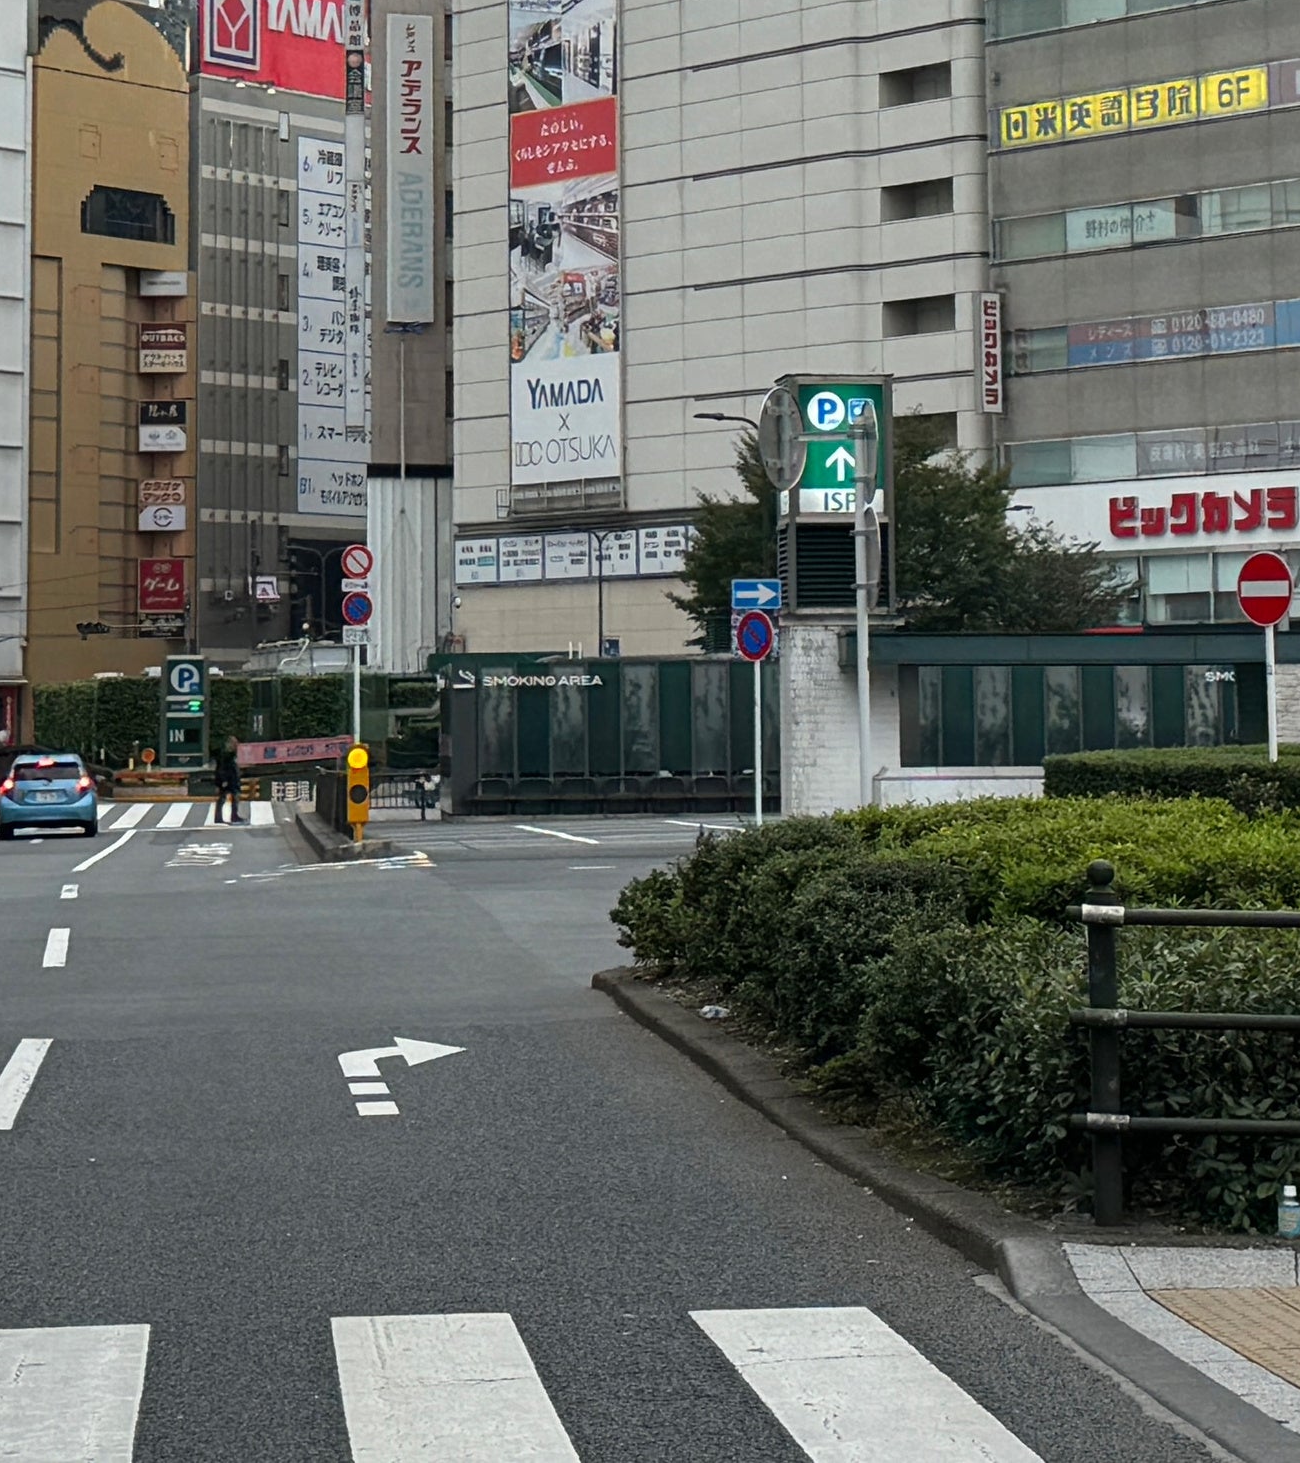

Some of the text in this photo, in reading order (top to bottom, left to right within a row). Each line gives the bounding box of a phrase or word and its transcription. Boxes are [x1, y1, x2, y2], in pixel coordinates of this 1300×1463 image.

[400, 59, 423, 155] アデランス
[1216, 74, 1251, 109] 6F
[397, 171, 424, 289] ADERANS
[983, 299, 999, 406] ビックカメラ
[526, 377, 604, 410] YAMADA
[546, 434, 616, 465] OTSUKA
[1109, 486, 1300, 538] ビックカメラ
[482, 674, 604, 688] SMOKING AREA
[169, 729, 186, 743] IN
